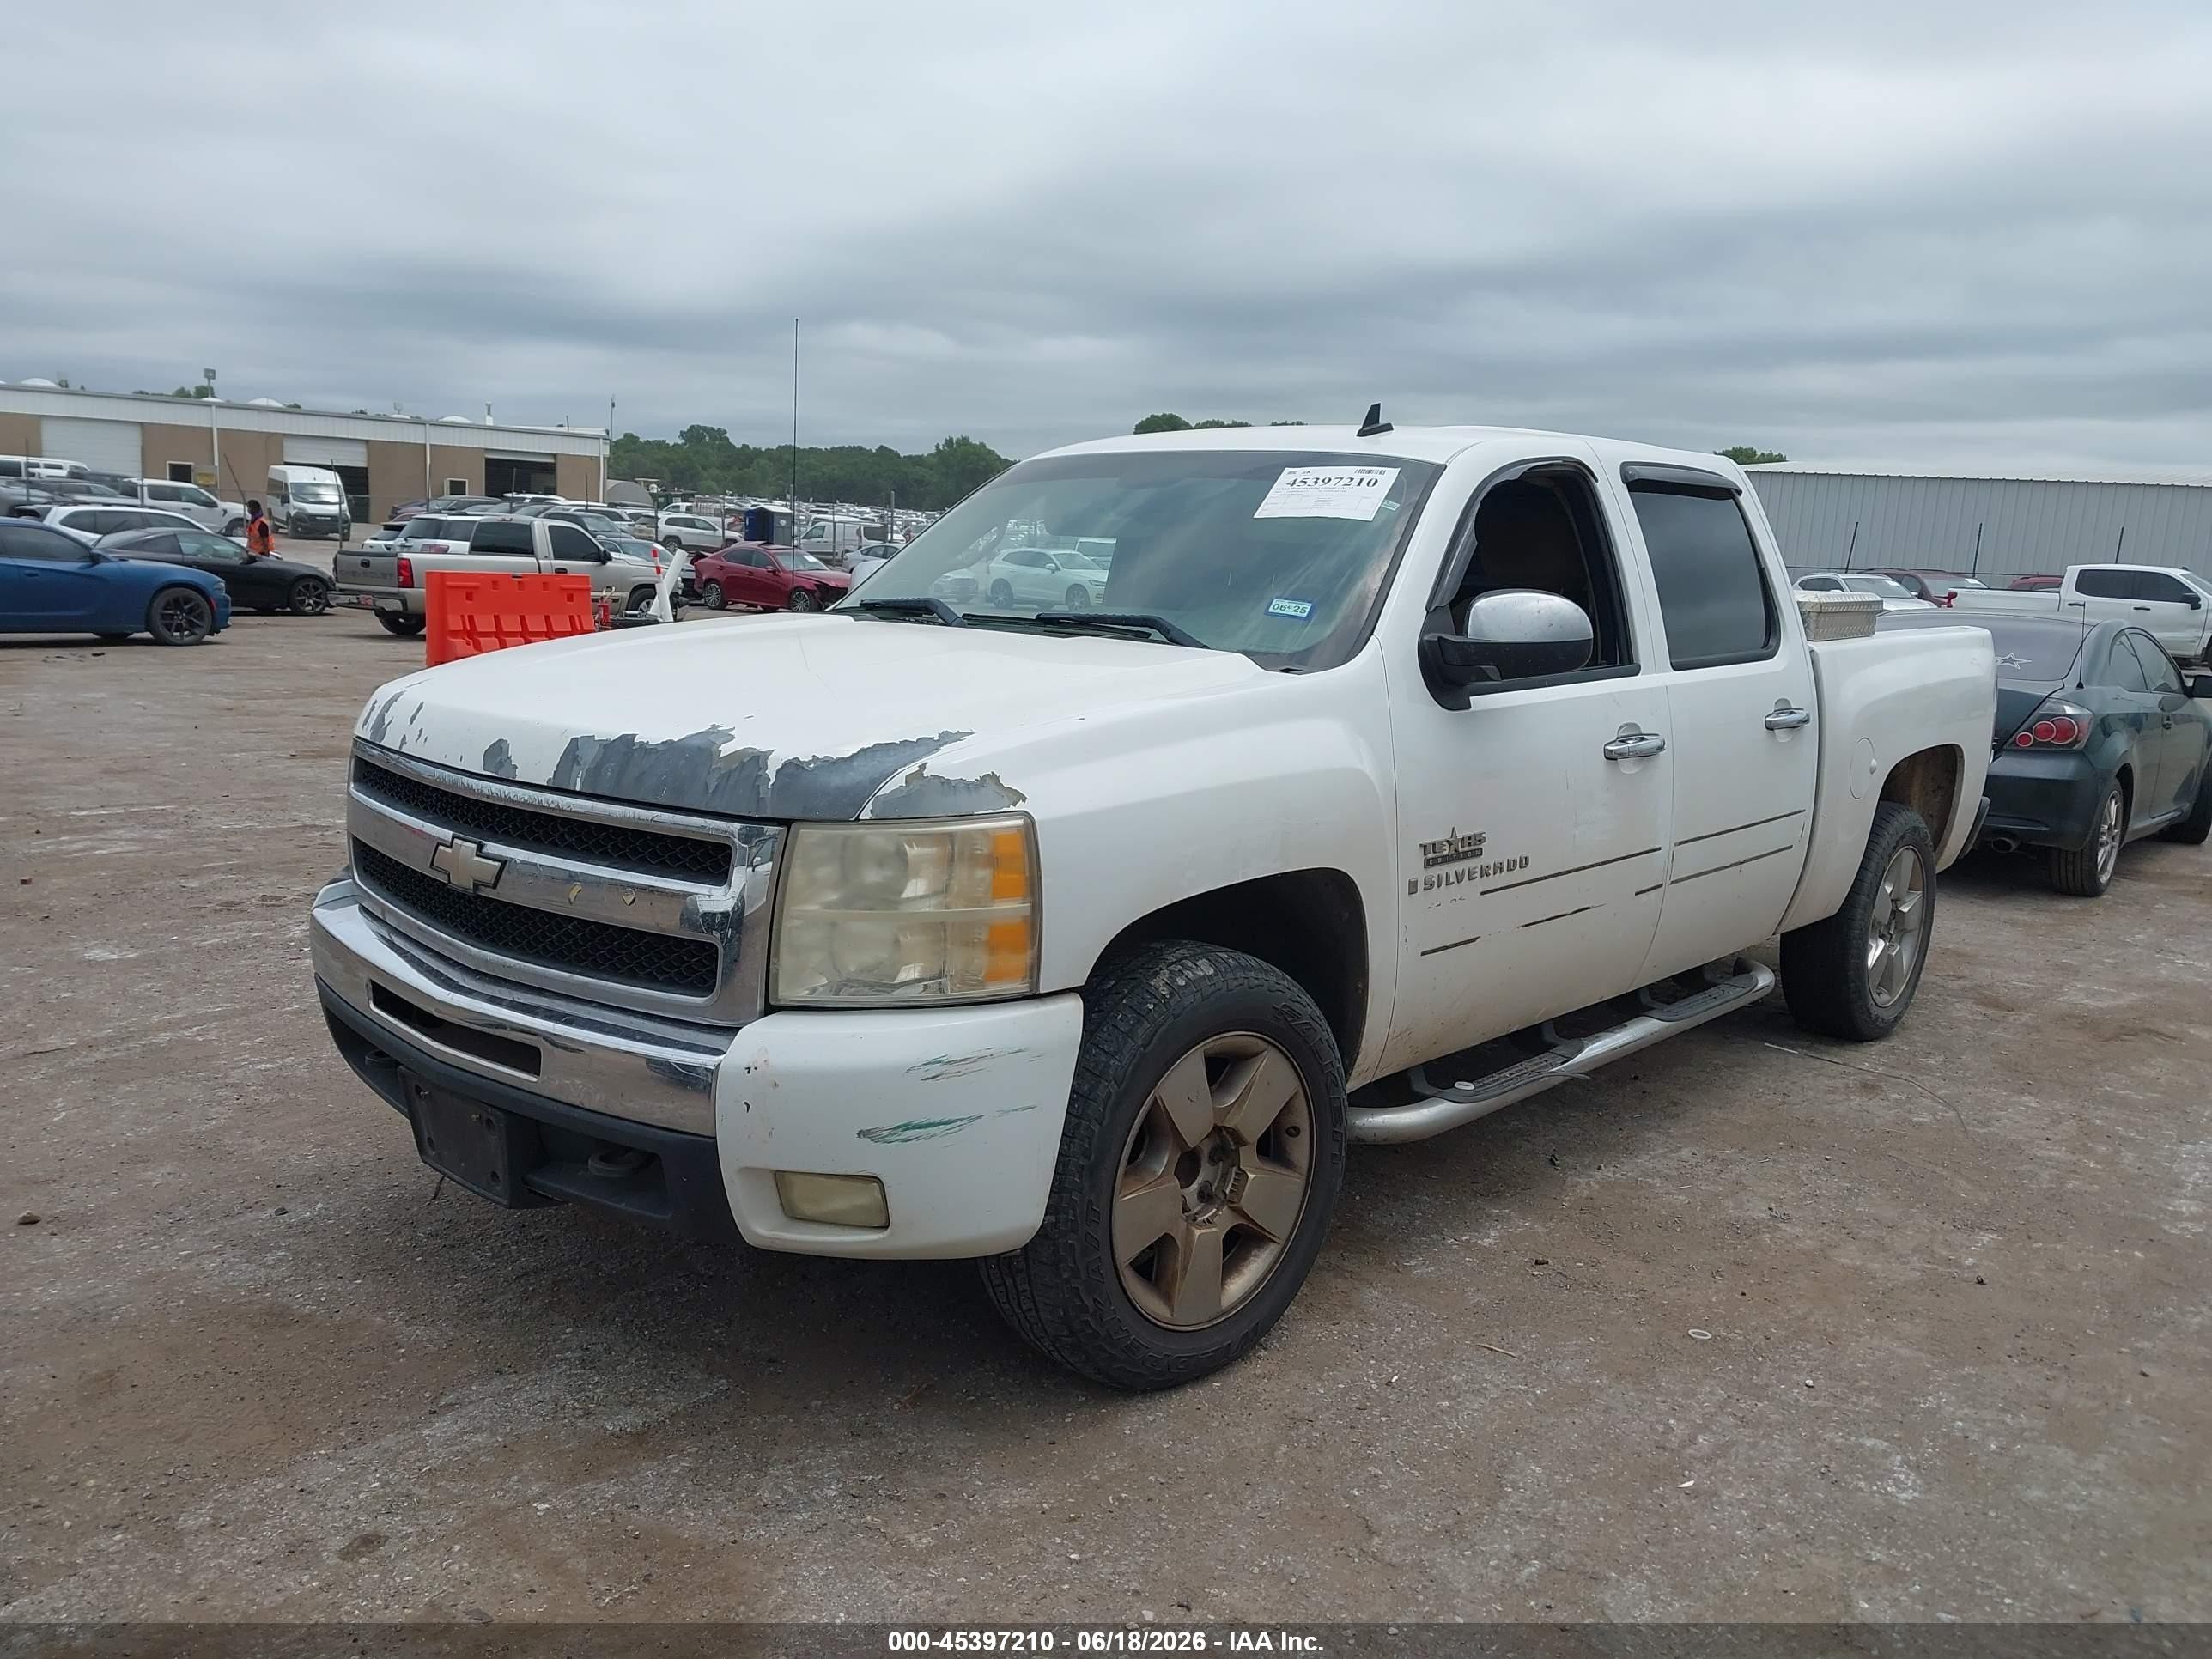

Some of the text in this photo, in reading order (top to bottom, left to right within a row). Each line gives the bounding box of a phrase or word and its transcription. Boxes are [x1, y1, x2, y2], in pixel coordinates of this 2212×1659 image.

[1285, 477, 1378, 488] 45397210
[1272, 603, 1309, 615] 06 25
[1419, 826, 1486, 855] TEXAS
[1427, 849, 1483, 866] EDITION
[1422, 854, 1531, 891] SILVERADO
